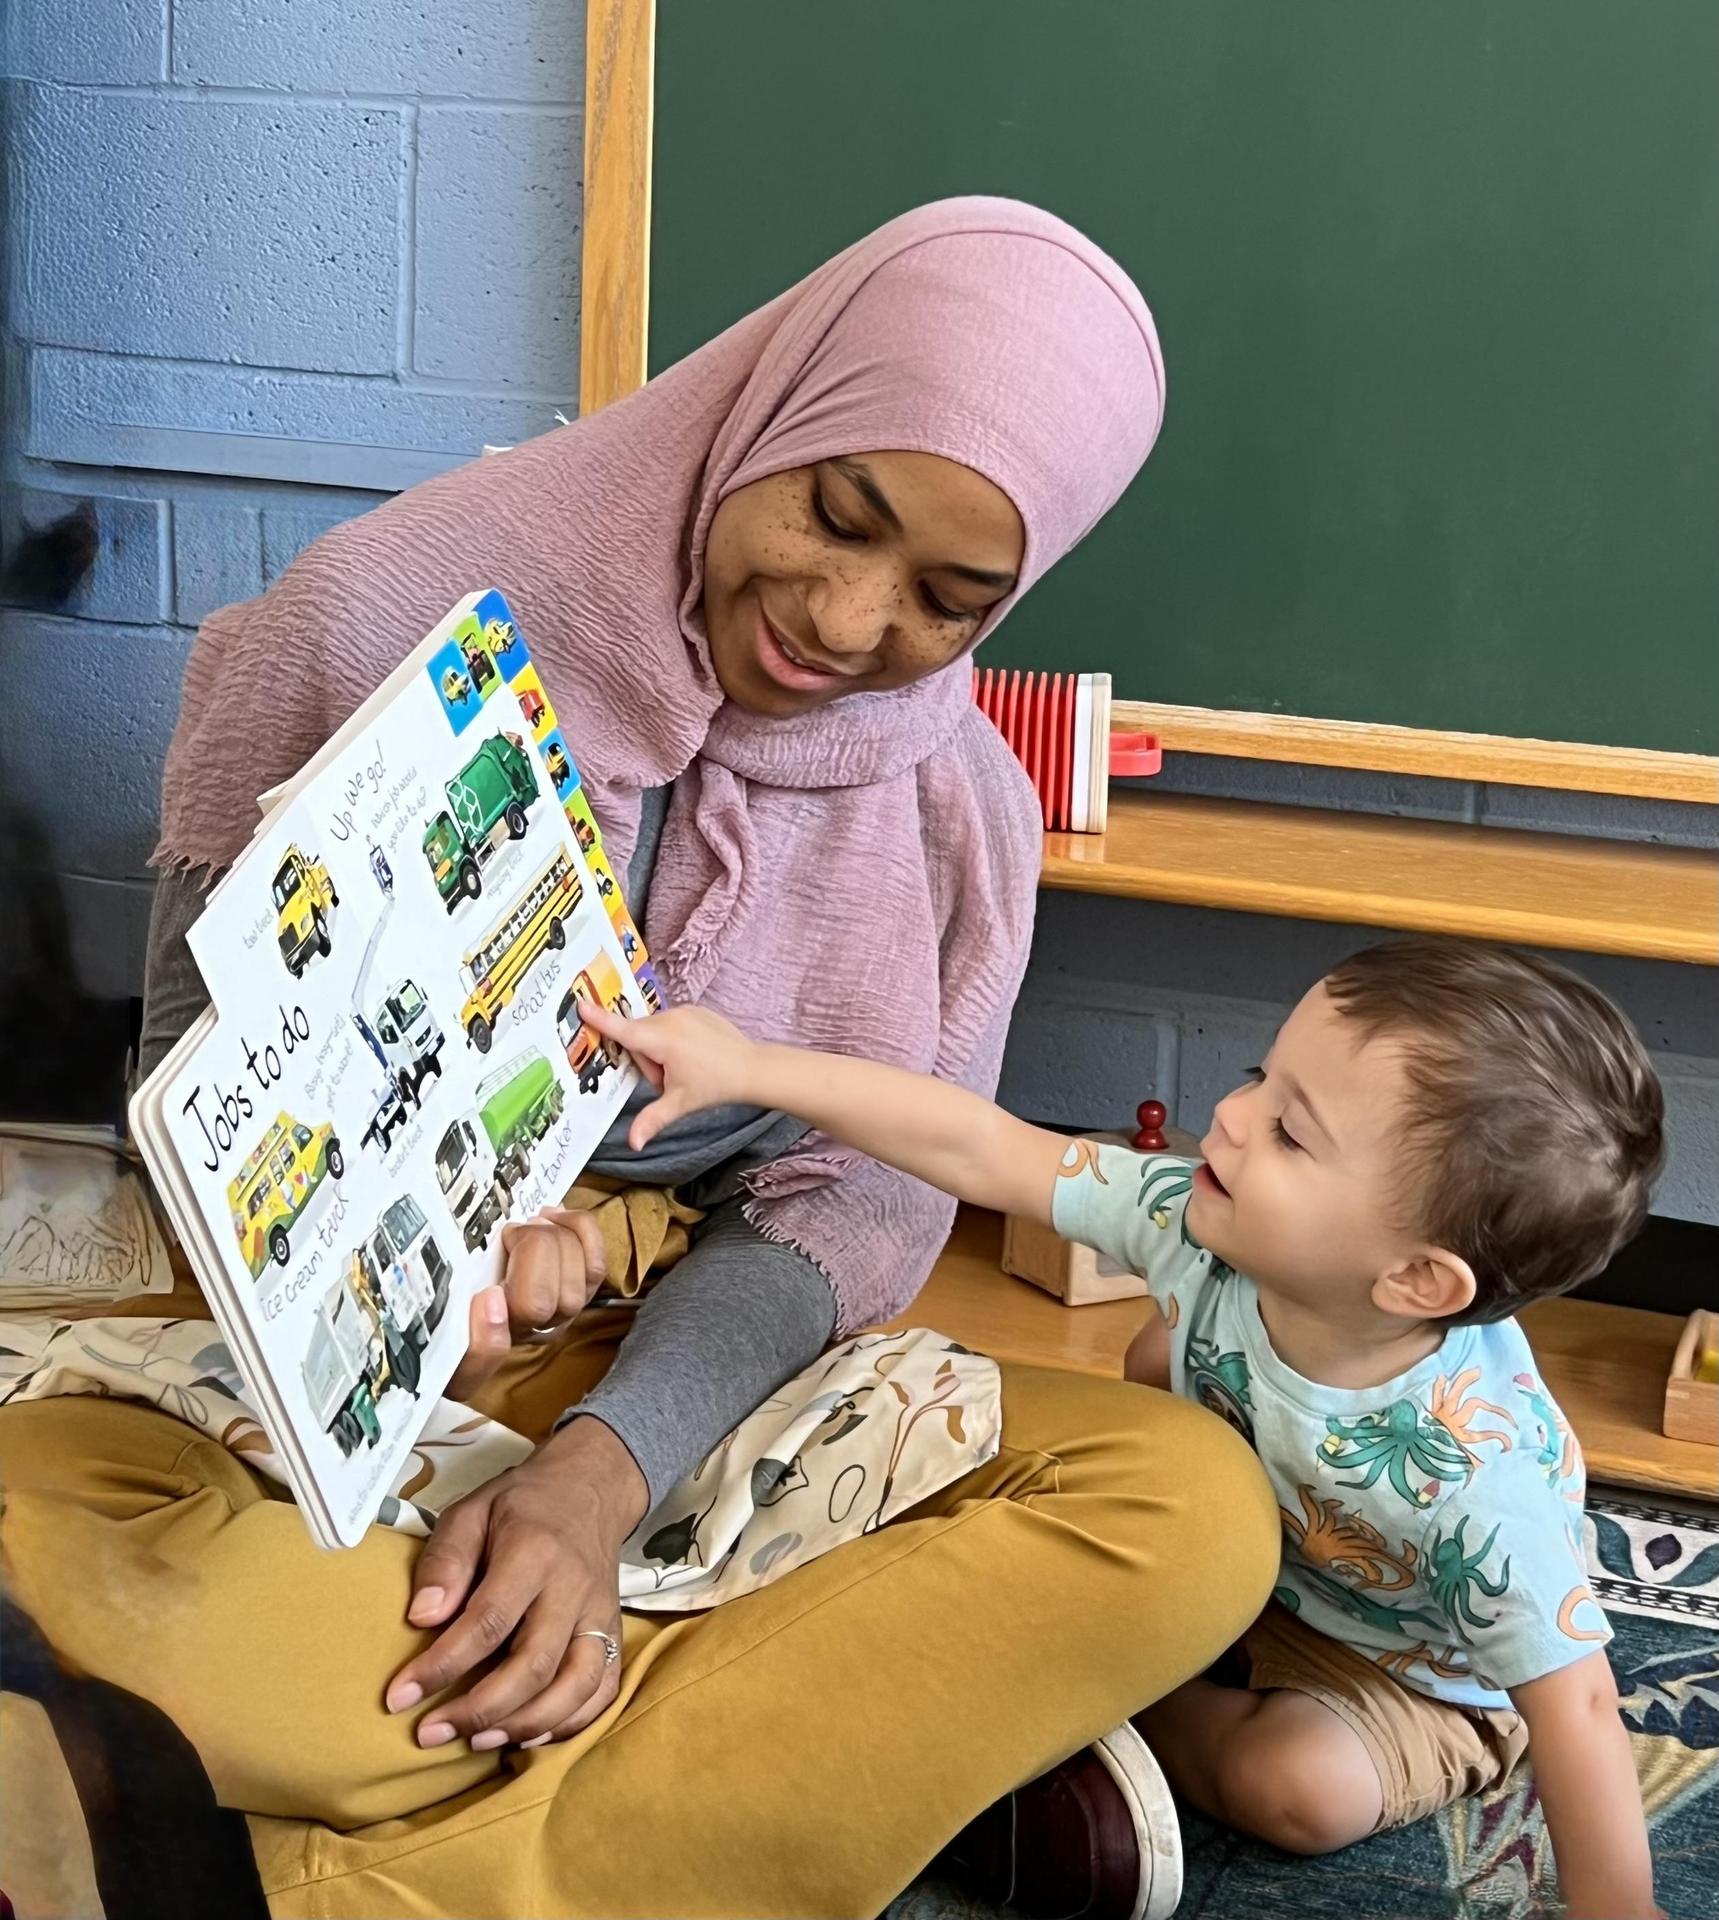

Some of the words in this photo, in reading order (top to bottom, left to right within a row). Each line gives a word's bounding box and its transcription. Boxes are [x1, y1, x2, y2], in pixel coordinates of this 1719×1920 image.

[329, 811, 358, 841] Up
[366, 739, 386, 794] go!
[182, 1082, 253, 1172] Jobs
[241, 1037, 282, 1090] to
[279, 1004, 310, 1054] do
[519, 1175, 548, 1218] fuel
[541, 1119, 572, 1185] tanker
[260, 1297, 284, 1322] ice
[285, 1250, 323, 1303] cream
[315, 1180, 349, 1248] truck
